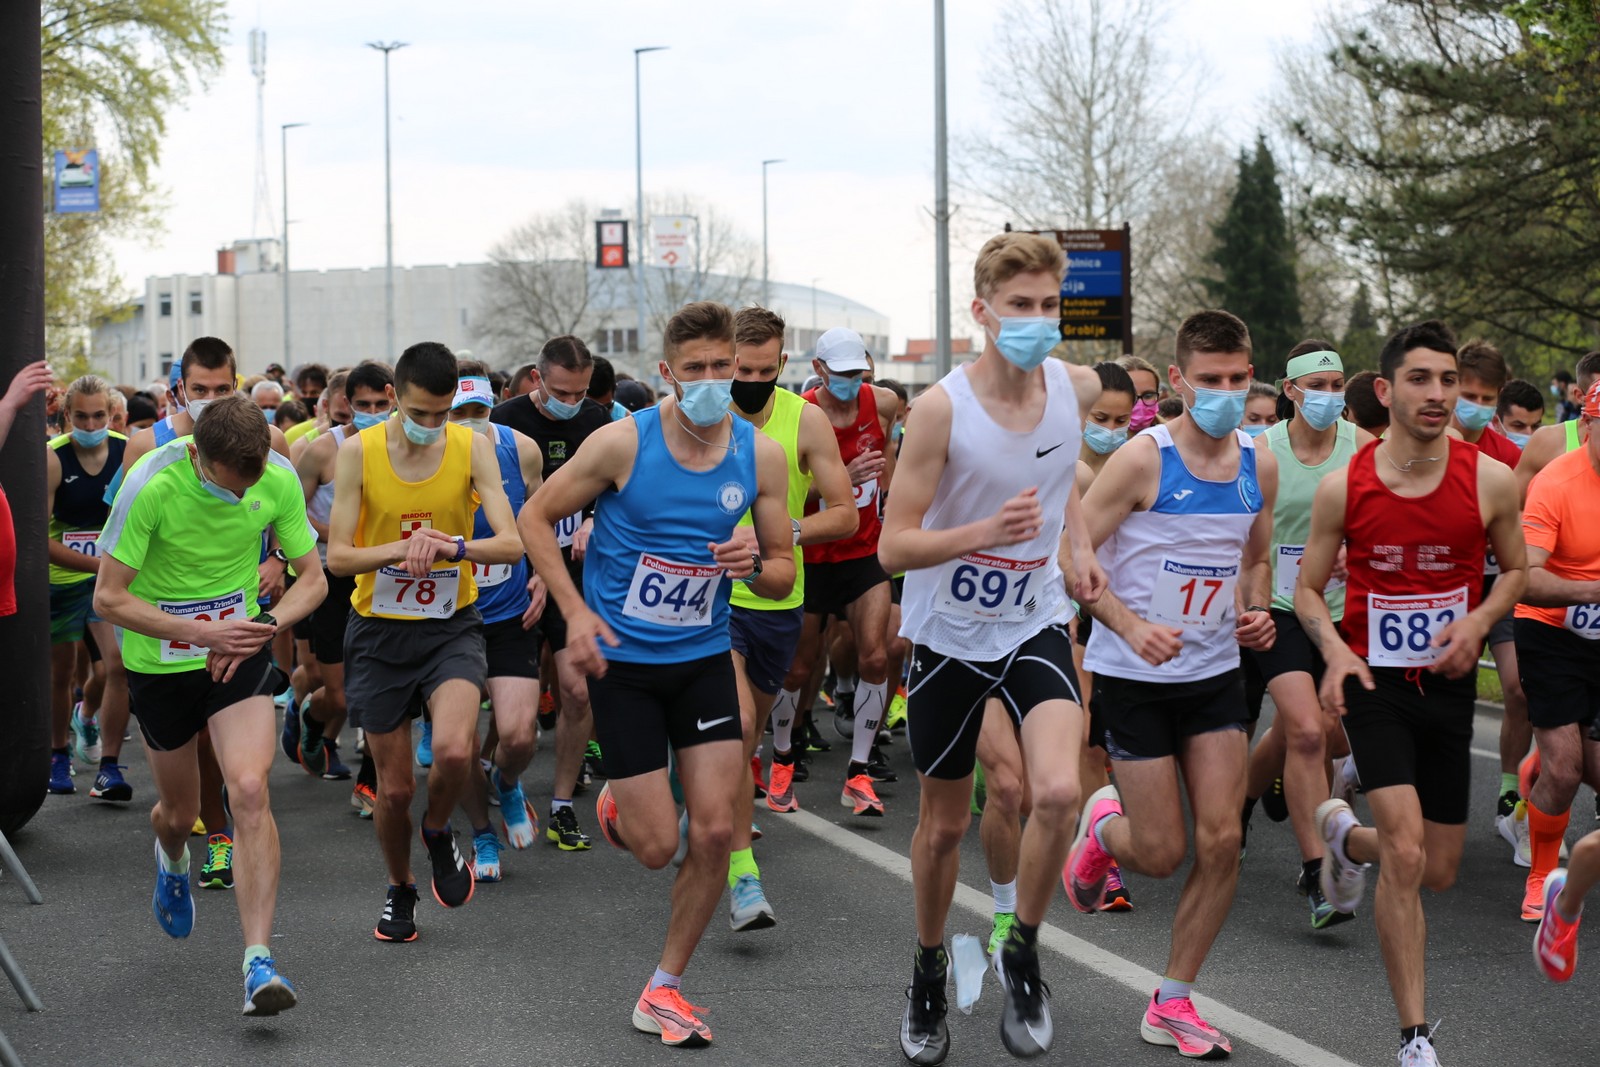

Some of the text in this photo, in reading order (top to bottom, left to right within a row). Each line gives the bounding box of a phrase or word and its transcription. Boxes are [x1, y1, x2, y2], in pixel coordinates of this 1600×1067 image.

[1068, 257, 1102, 268] olnica
[1062, 280, 1085, 293] cija
[1063, 324, 1106, 337] Groblje
[400, 511, 432, 519] MLADOST
[961, 551, 1011, 569] olumaraton
[382, 567, 412, 577] Poluma
[645, 558, 694, 576] Polumaraton
[1167, 562, 1214, 576] Polumaraton
[394, 578, 436, 605] 78
[639, 572, 711, 612] 644
[951, 564, 1032, 608] 691
[1180, 578, 1223, 616] 17
[163, 604, 211, 614] Polumaraton
[1374, 599, 1430, 609] Polumaraton
